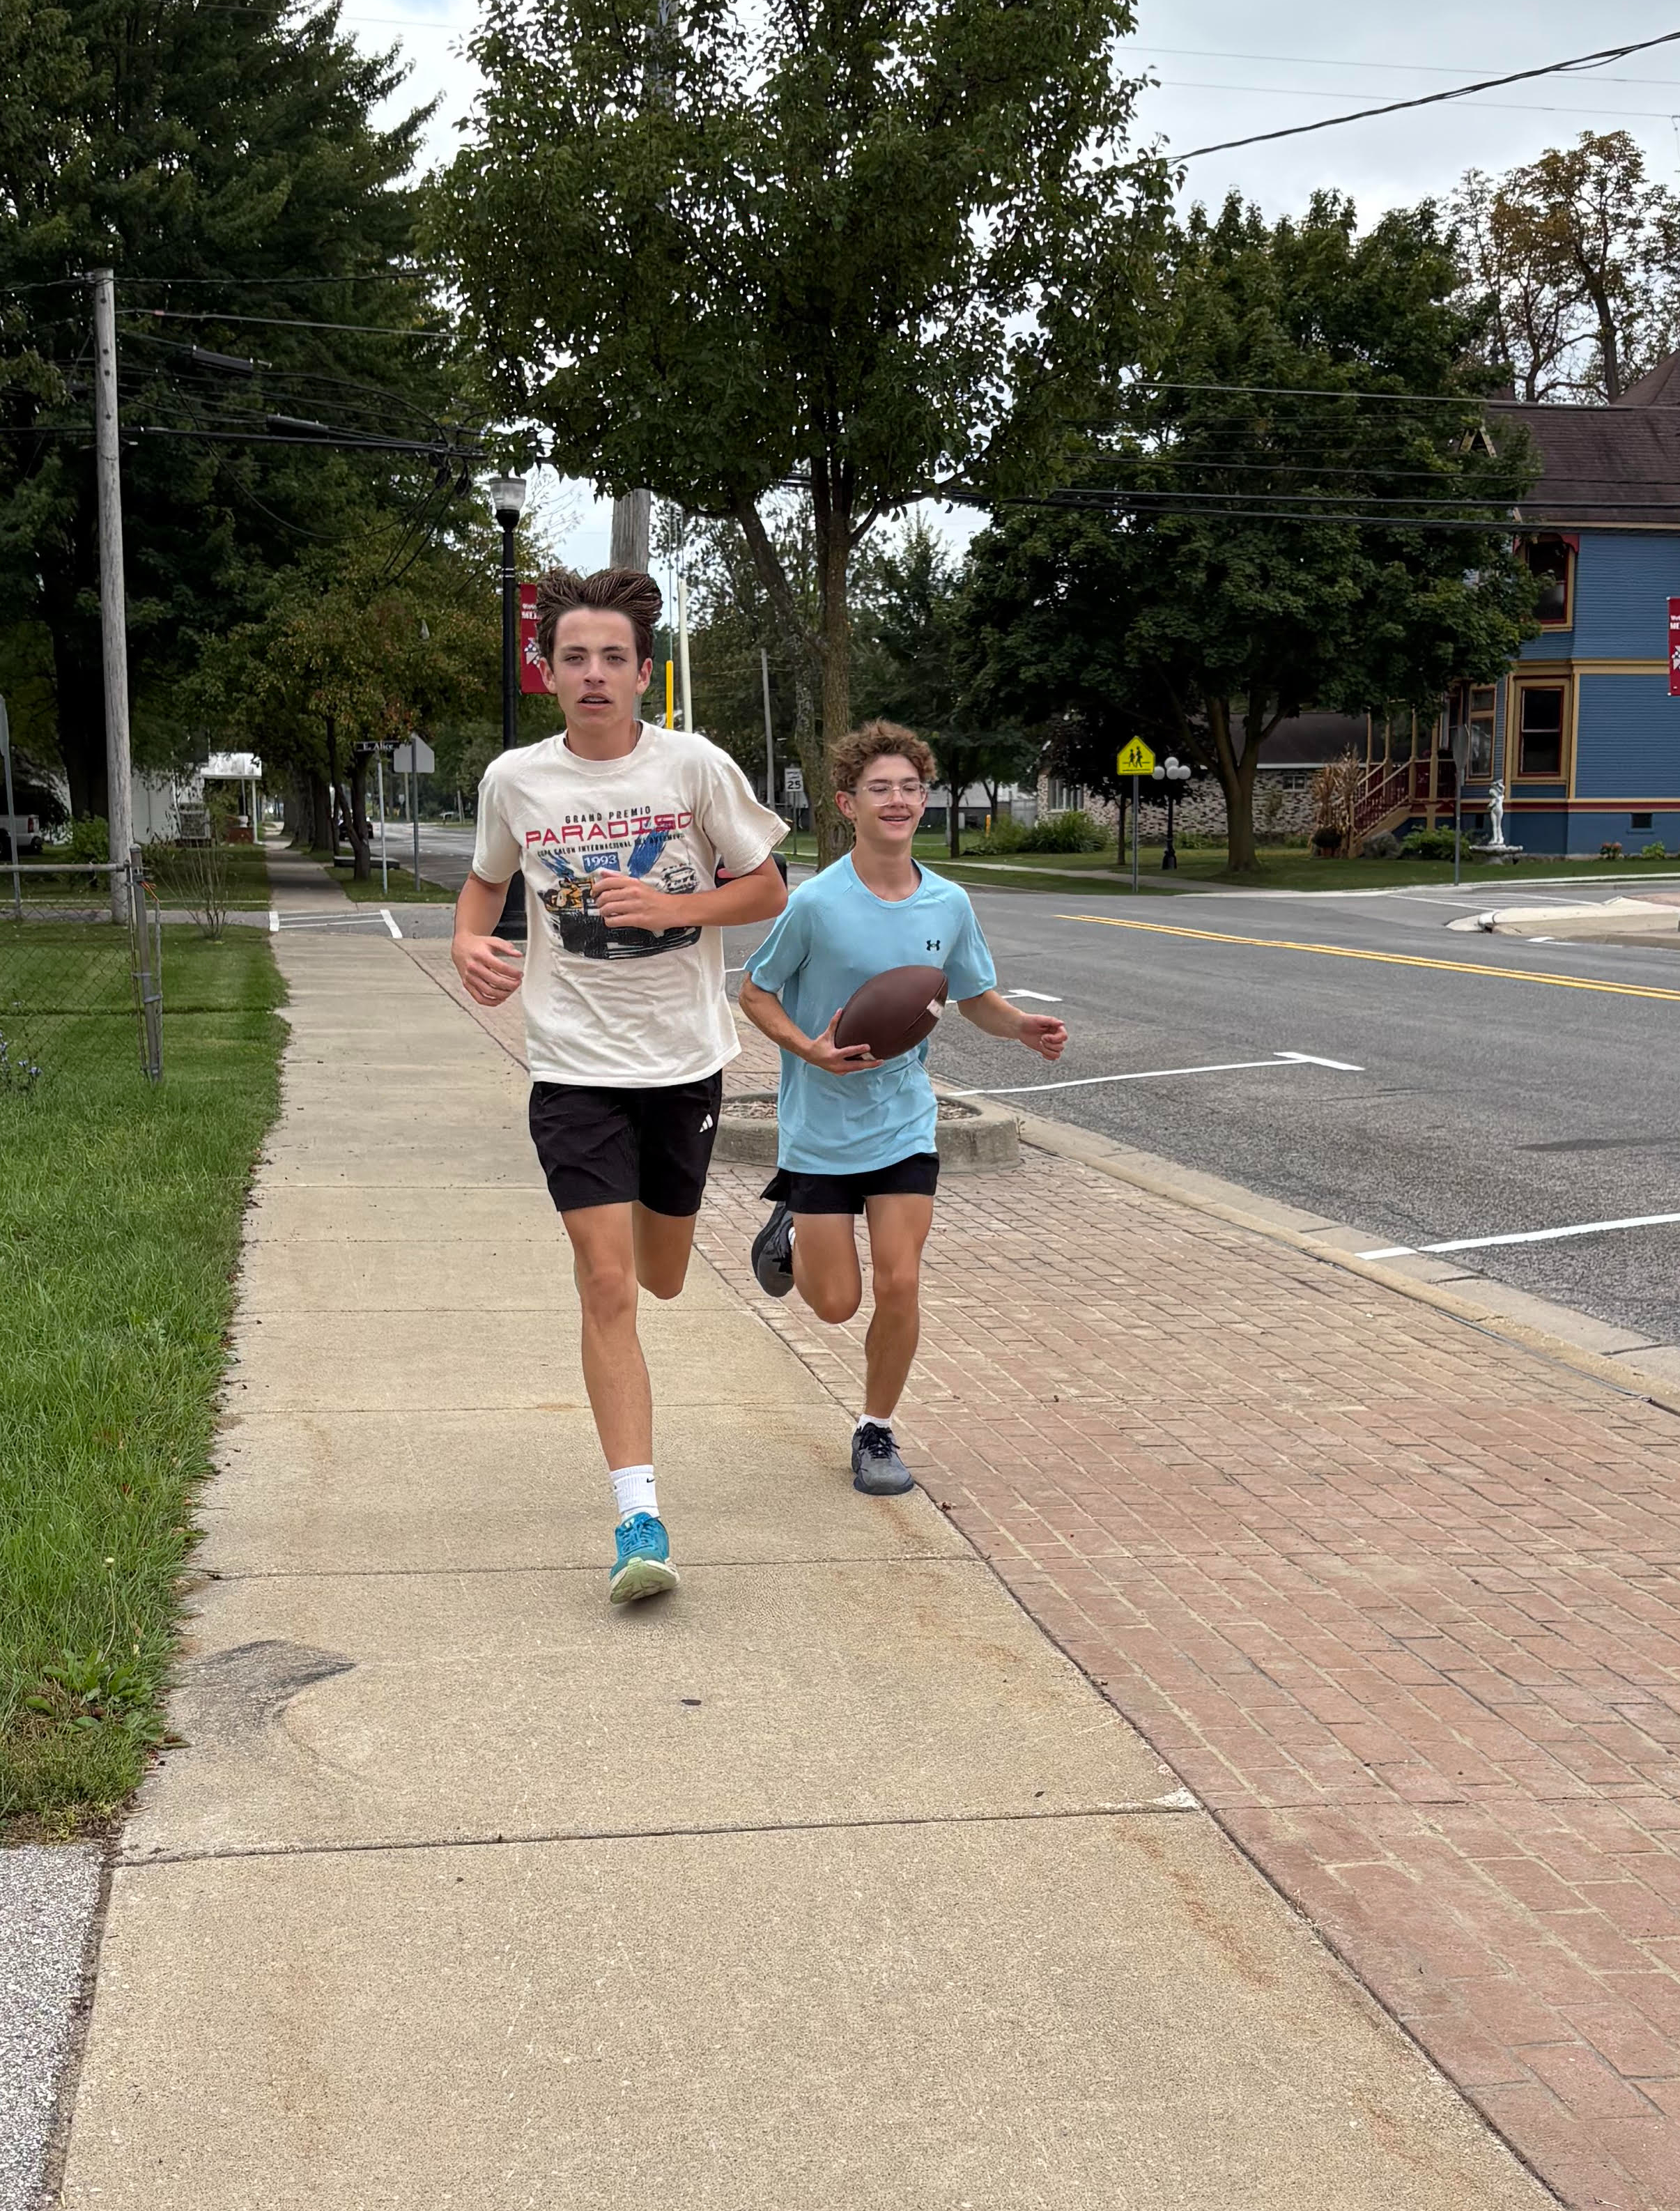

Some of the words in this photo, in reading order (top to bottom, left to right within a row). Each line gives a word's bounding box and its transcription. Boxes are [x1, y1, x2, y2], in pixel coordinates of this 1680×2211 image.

[787, 780, 801, 789] 25
[565, 812, 603, 824] GRAND
[608, 806, 651, 820] PREMIO
[525, 811, 693, 849] PARADISO
[584, 854, 617, 866] 1993
